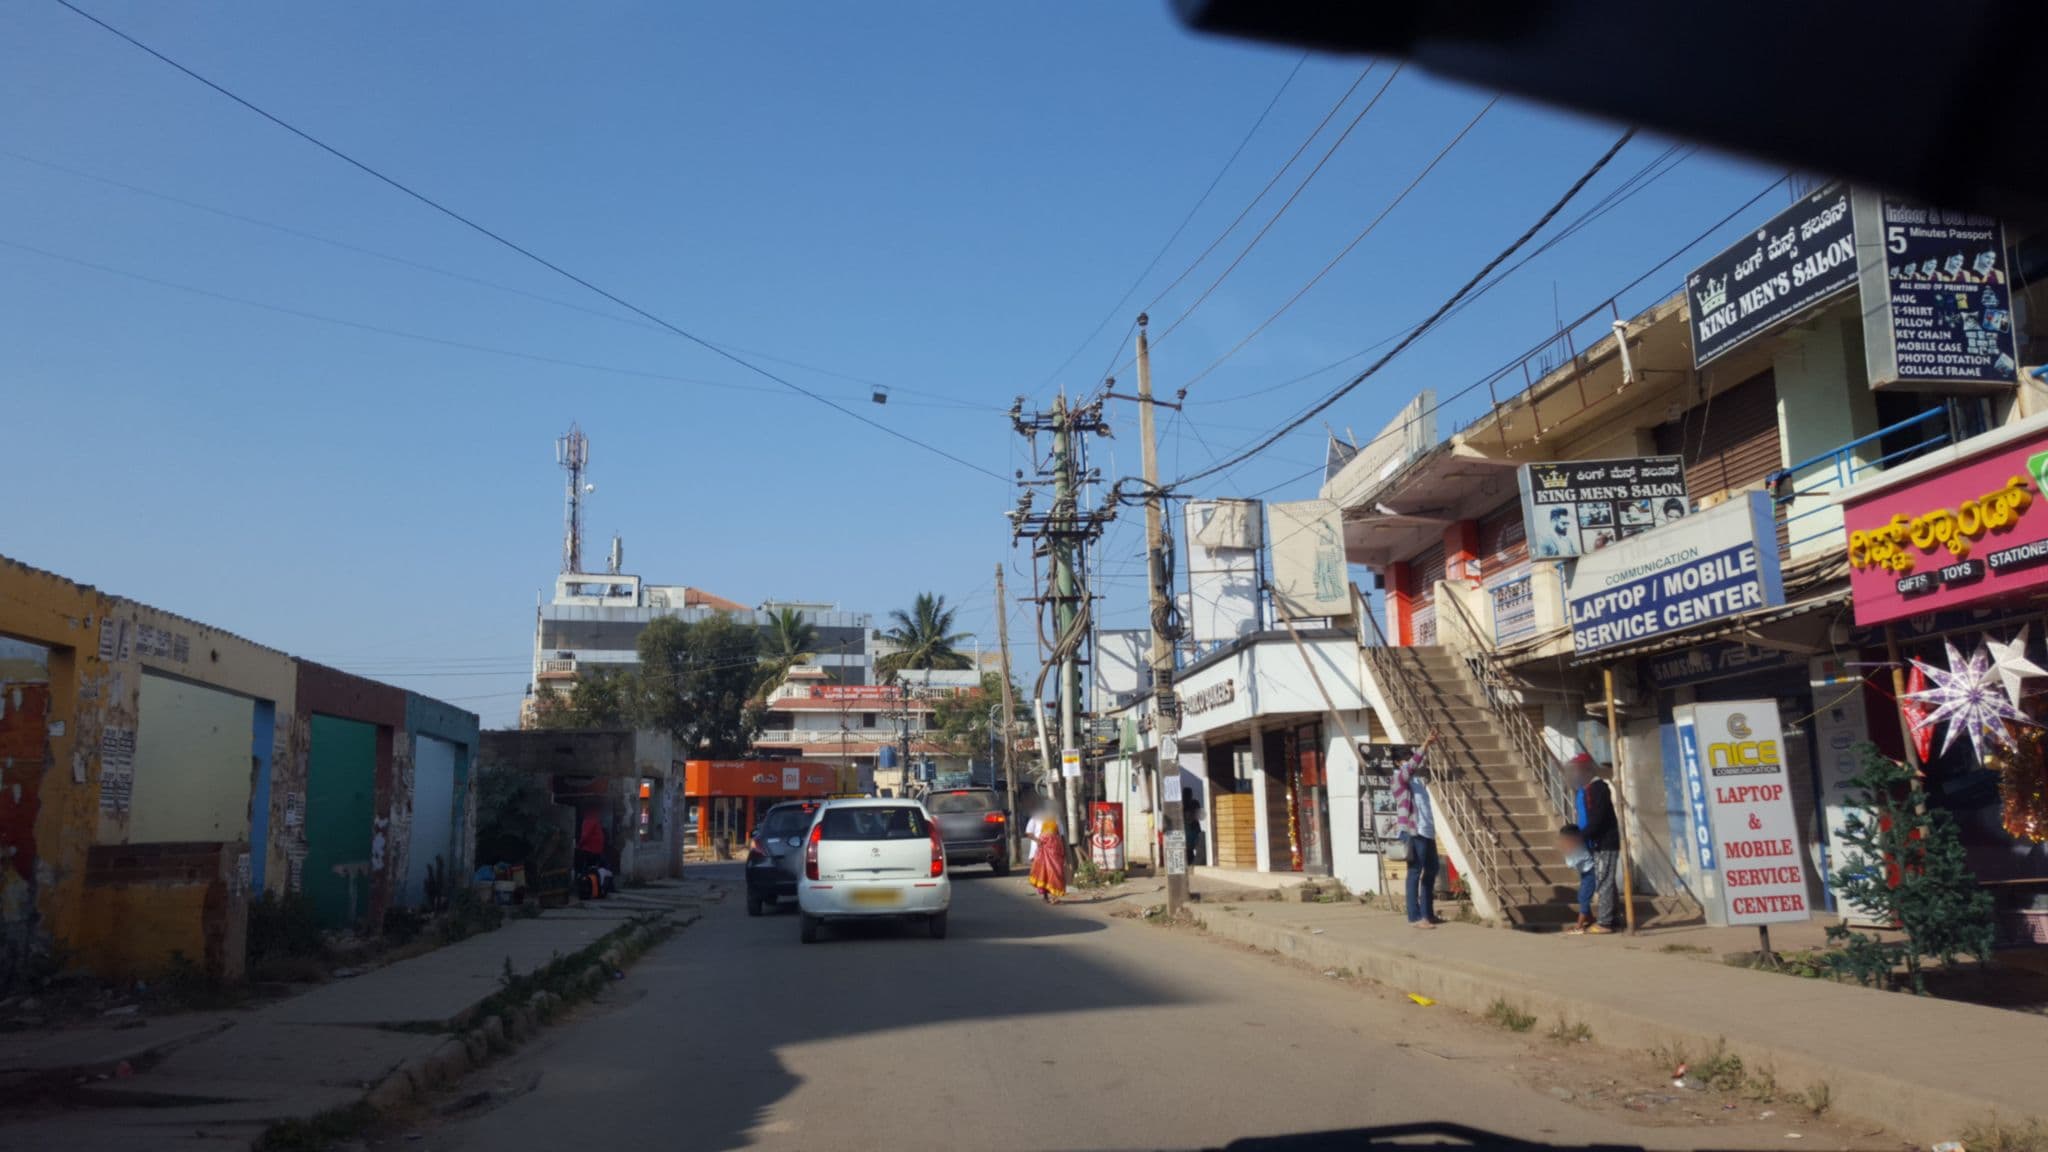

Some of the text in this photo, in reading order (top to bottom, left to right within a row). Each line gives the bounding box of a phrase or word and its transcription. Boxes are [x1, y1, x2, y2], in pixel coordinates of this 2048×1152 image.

[1888, 227, 1907, 254] 5
[1910, 227, 1992, 241] Minutes Passport
[1698, 302, 1737, 342] KING
[1738, 271, 1791, 318] MEN'S
[1792, 233, 1856, 287] SALON
[1900, 282, 1912, 290] ALL
[1944, 284, 1979, 292] PRINTING
[1893, 295, 1917, 304] MUG
[1894, 306, 1934, 316] T-SHIRT
[1895, 318, 1933, 328] PILLOW
[1896, 330, 1951, 340] KEY CHAIN
[1897, 342, 1962, 352] MOBILE CASE
[1899, 353, 1991, 365] PHOTO ROTATION
[1899, 365, 1982, 377] COLLAGE FRAME
[1536, 483, 1684, 503] KING MEN'S SALON
[1605, 546, 1699, 586] COMMUNICATION
[1942, 563, 1971, 580] TOYS
[1572, 584, 1646, 624] LAPTOP
[1652, 579, 1658, 601] /
[1663, 547, 1756, 597] MOBILE
[1898, 575, 1928, 592] GIFTS
[1575, 581, 1761, 651] SERVICE CENTER
[1708, 740, 1780, 768] NICE
[1716, 767, 1778, 776] COMMUNICATION
[1684, 736, 1711, 867] LAPTOP
[1716, 784, 1783, 804] LAPTOP
[1748, 813, 1762, 830] &
[1724, 839, 1793, 858] MOBILE
[1726, 866, 1801, 887] SERVICE
[1732, 894, 1804, 915] CENTER
